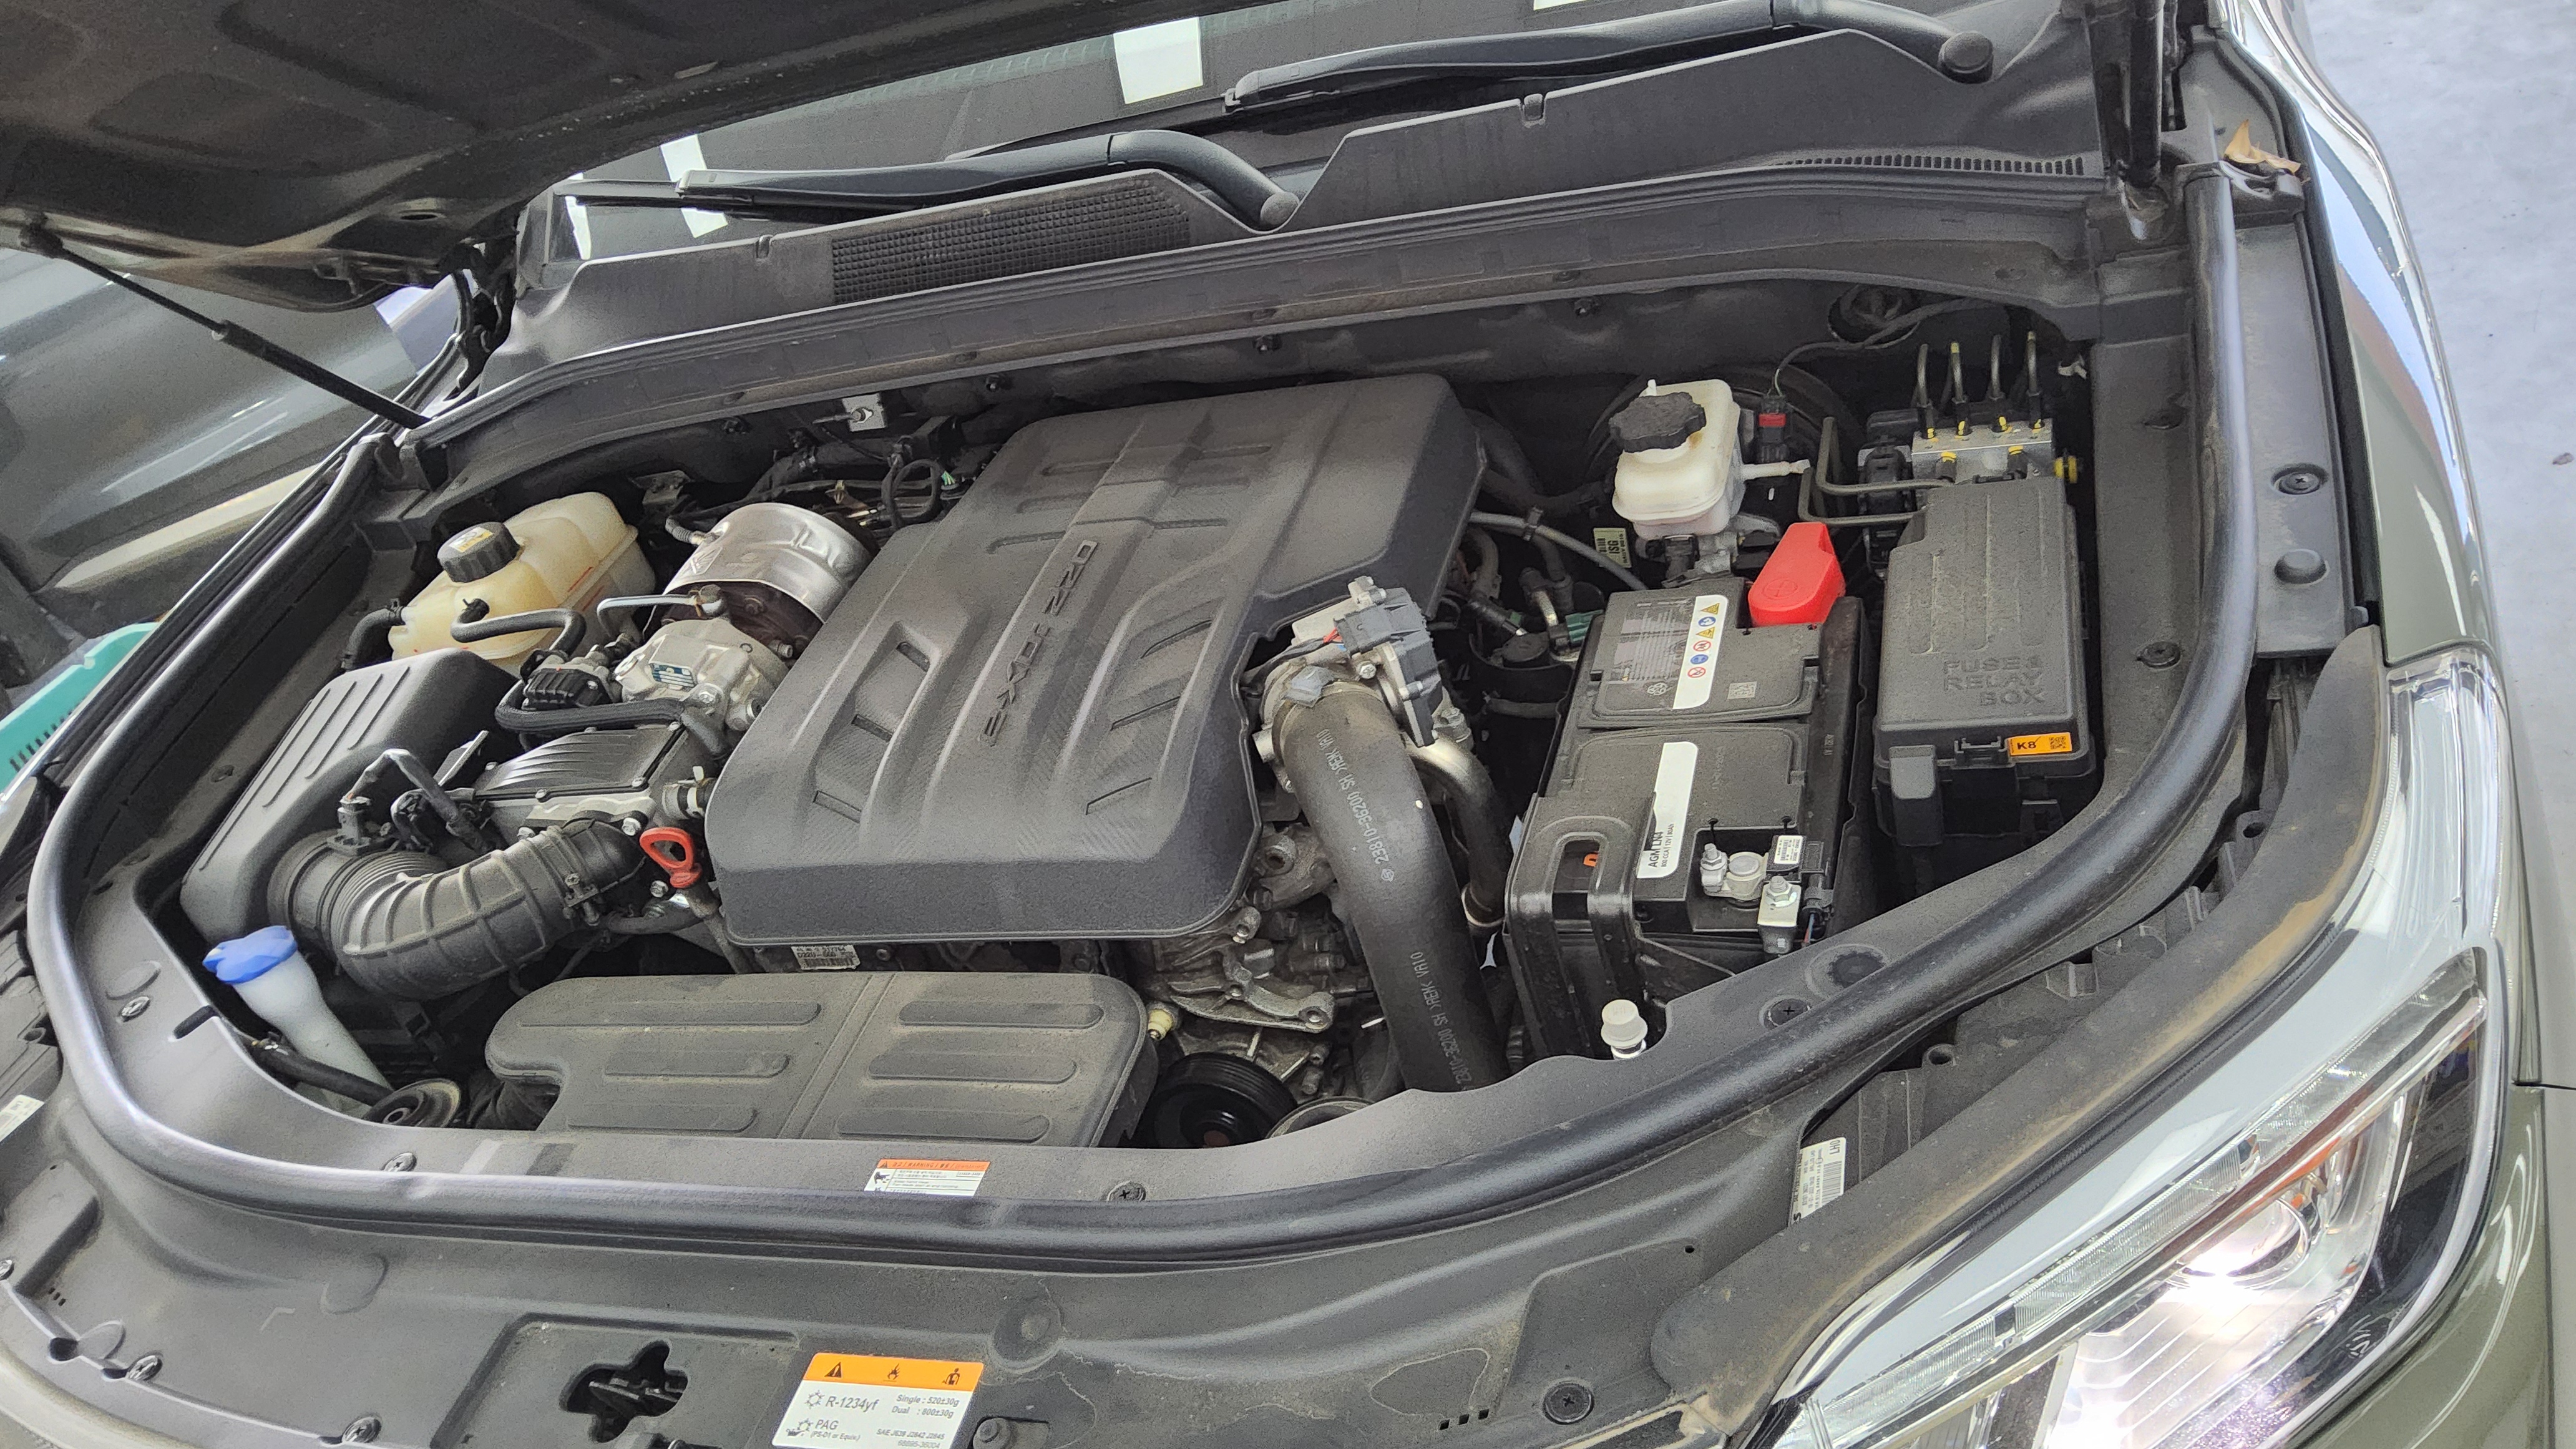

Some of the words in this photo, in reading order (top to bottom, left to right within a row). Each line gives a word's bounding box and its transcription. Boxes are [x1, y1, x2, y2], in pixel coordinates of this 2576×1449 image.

[1608, 540, 1620, 554] ISG
[1042, 540, 1098, 616] 220
[1943, 656, 2021, 674] FUSE
[1944, 672, 2042, 691] RELAY
[1979, 687, 2046, 706] BOX
[2017, 741, 2036, 749] K8
[1338, 773, 1355, 791] SH
[1346, 791, 1389, 865] 23810-36200
[1648, 848, 1661, 867] AGM
[825, 1396, 879, 1412] R-1234yf
[897, 1394, 920, 1405] Single
[927, 1397, 960, 1407] 520±30g
[891, 1405, 910, 1414] Dual
[922, 1407, 954, 1419] 800±30g
[815, 1420, 839, 1430] PAG
